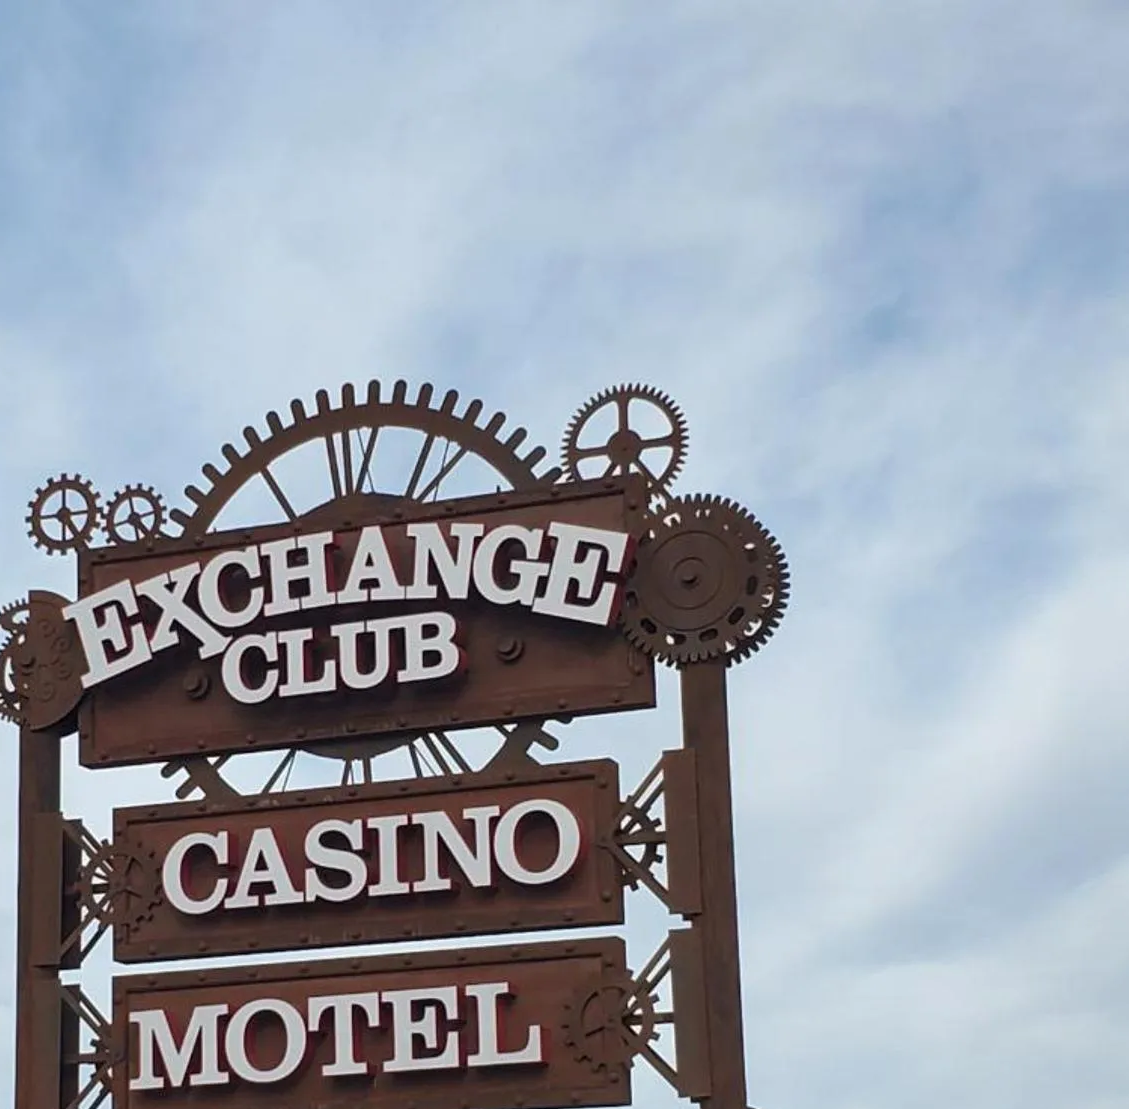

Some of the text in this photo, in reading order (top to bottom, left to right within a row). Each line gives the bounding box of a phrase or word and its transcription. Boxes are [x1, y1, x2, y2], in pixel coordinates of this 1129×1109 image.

[62, 521, 628, 688] EXCHANGE
[221, 610, 461, 704] CLUB
[161, 799, 581, 916] CASINO
[128, 981, 543, 1092] MOTEL
